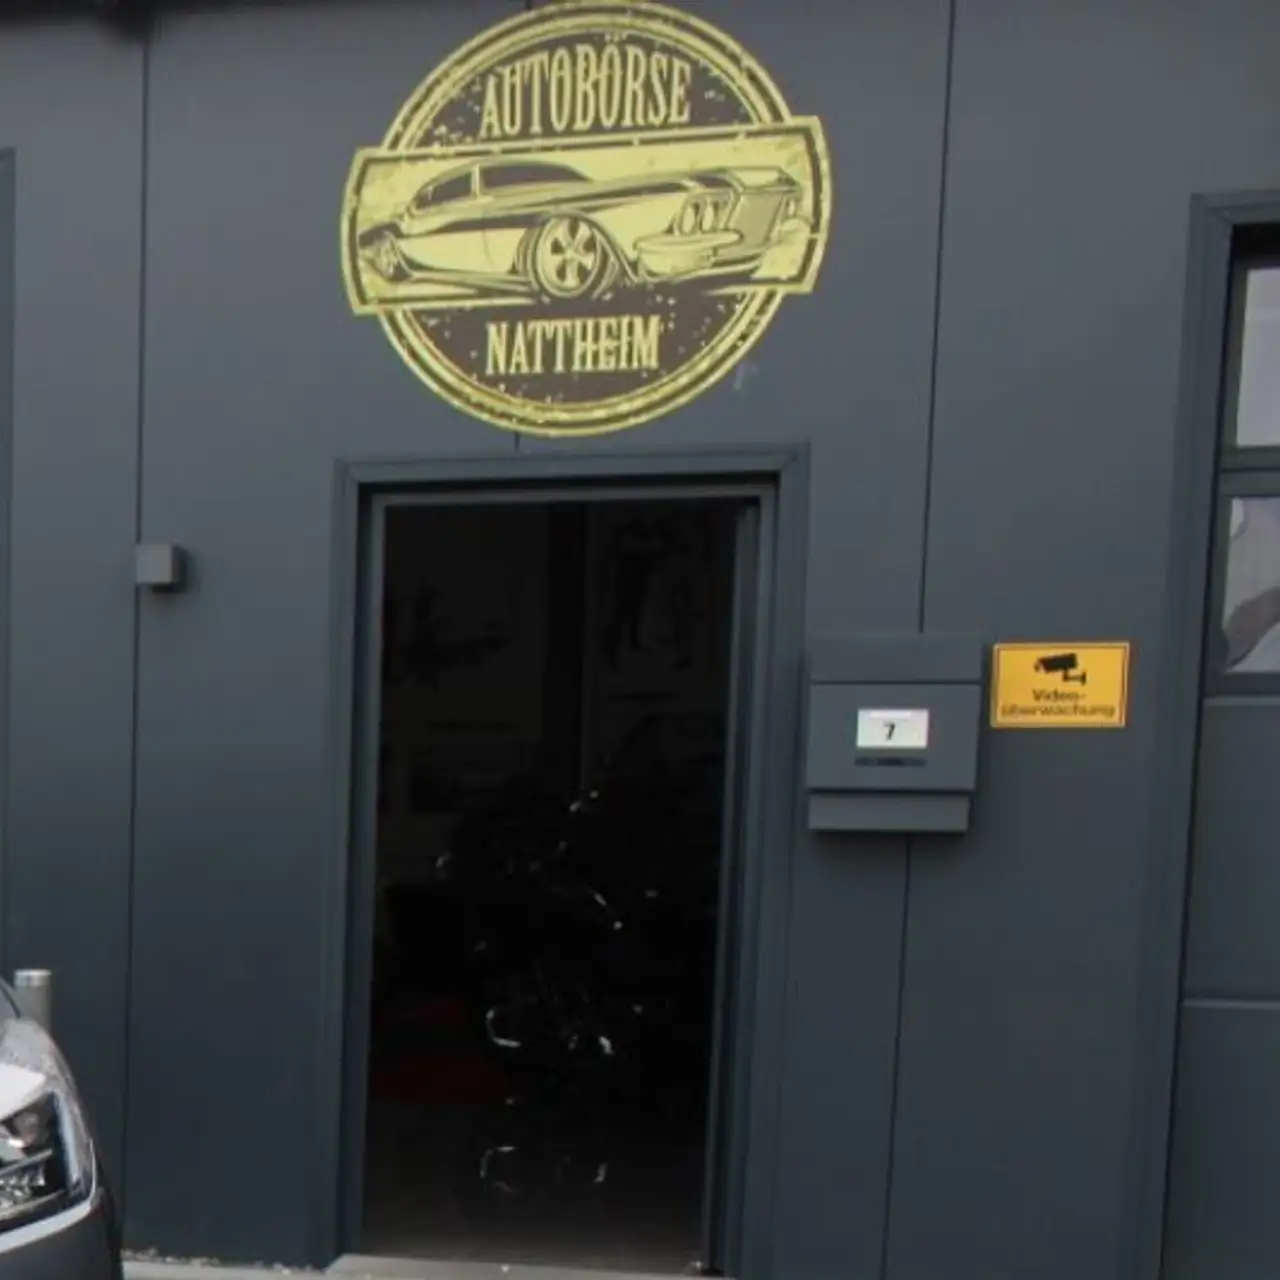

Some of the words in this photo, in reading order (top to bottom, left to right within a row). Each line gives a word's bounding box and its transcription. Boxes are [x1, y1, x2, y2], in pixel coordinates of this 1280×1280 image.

[479, 34, 693, 140] AUTOBÖRSE
[485, 315, 663, 375] NATTHEIM
[882, 720, 897, 741] 7
